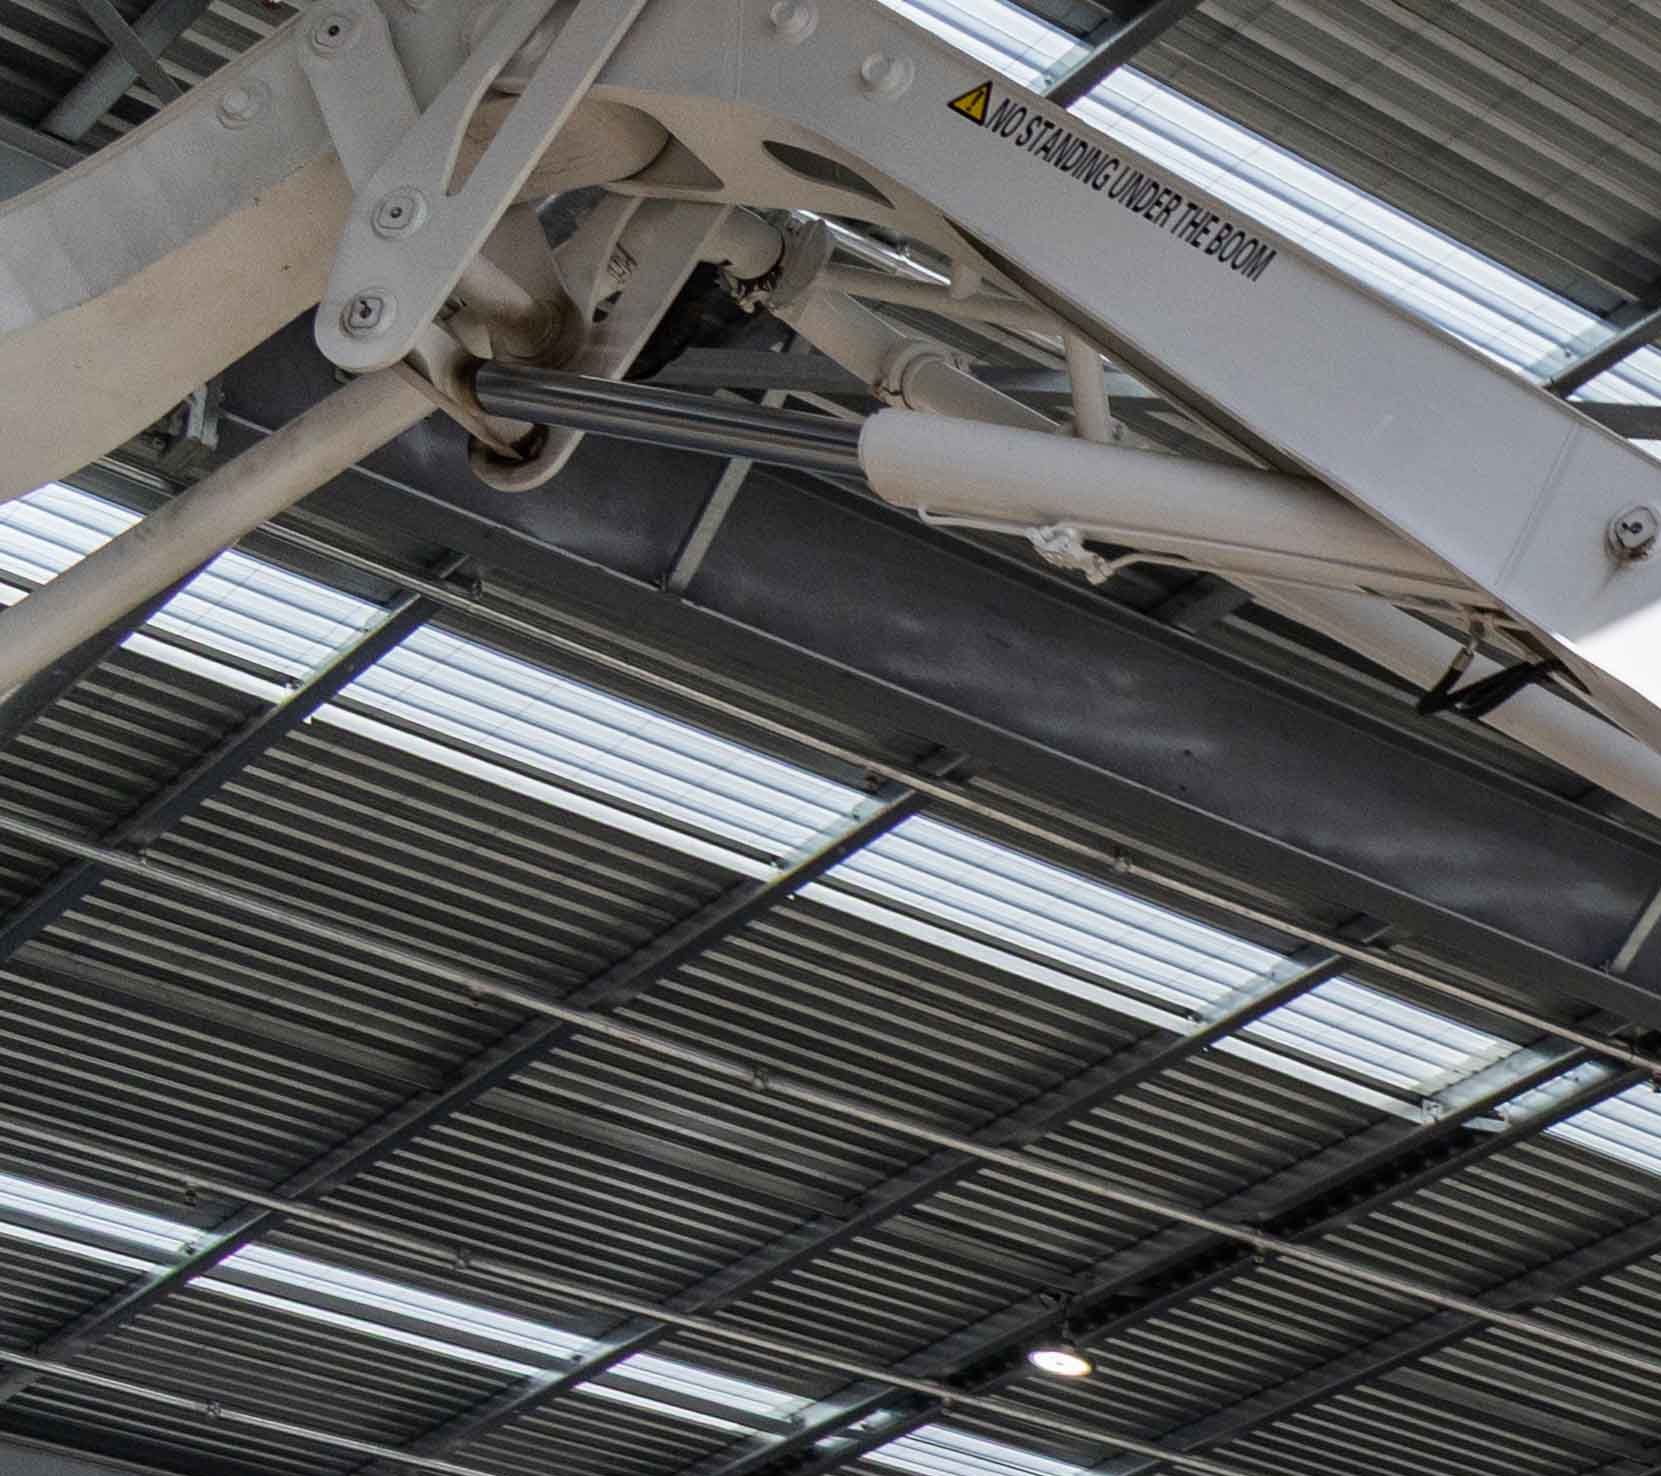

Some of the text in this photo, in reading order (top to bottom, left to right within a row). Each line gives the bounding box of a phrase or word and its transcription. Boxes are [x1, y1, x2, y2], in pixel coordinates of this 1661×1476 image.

[987, 98, 1278, 283] NO STANDING UNDER THE BOOM
